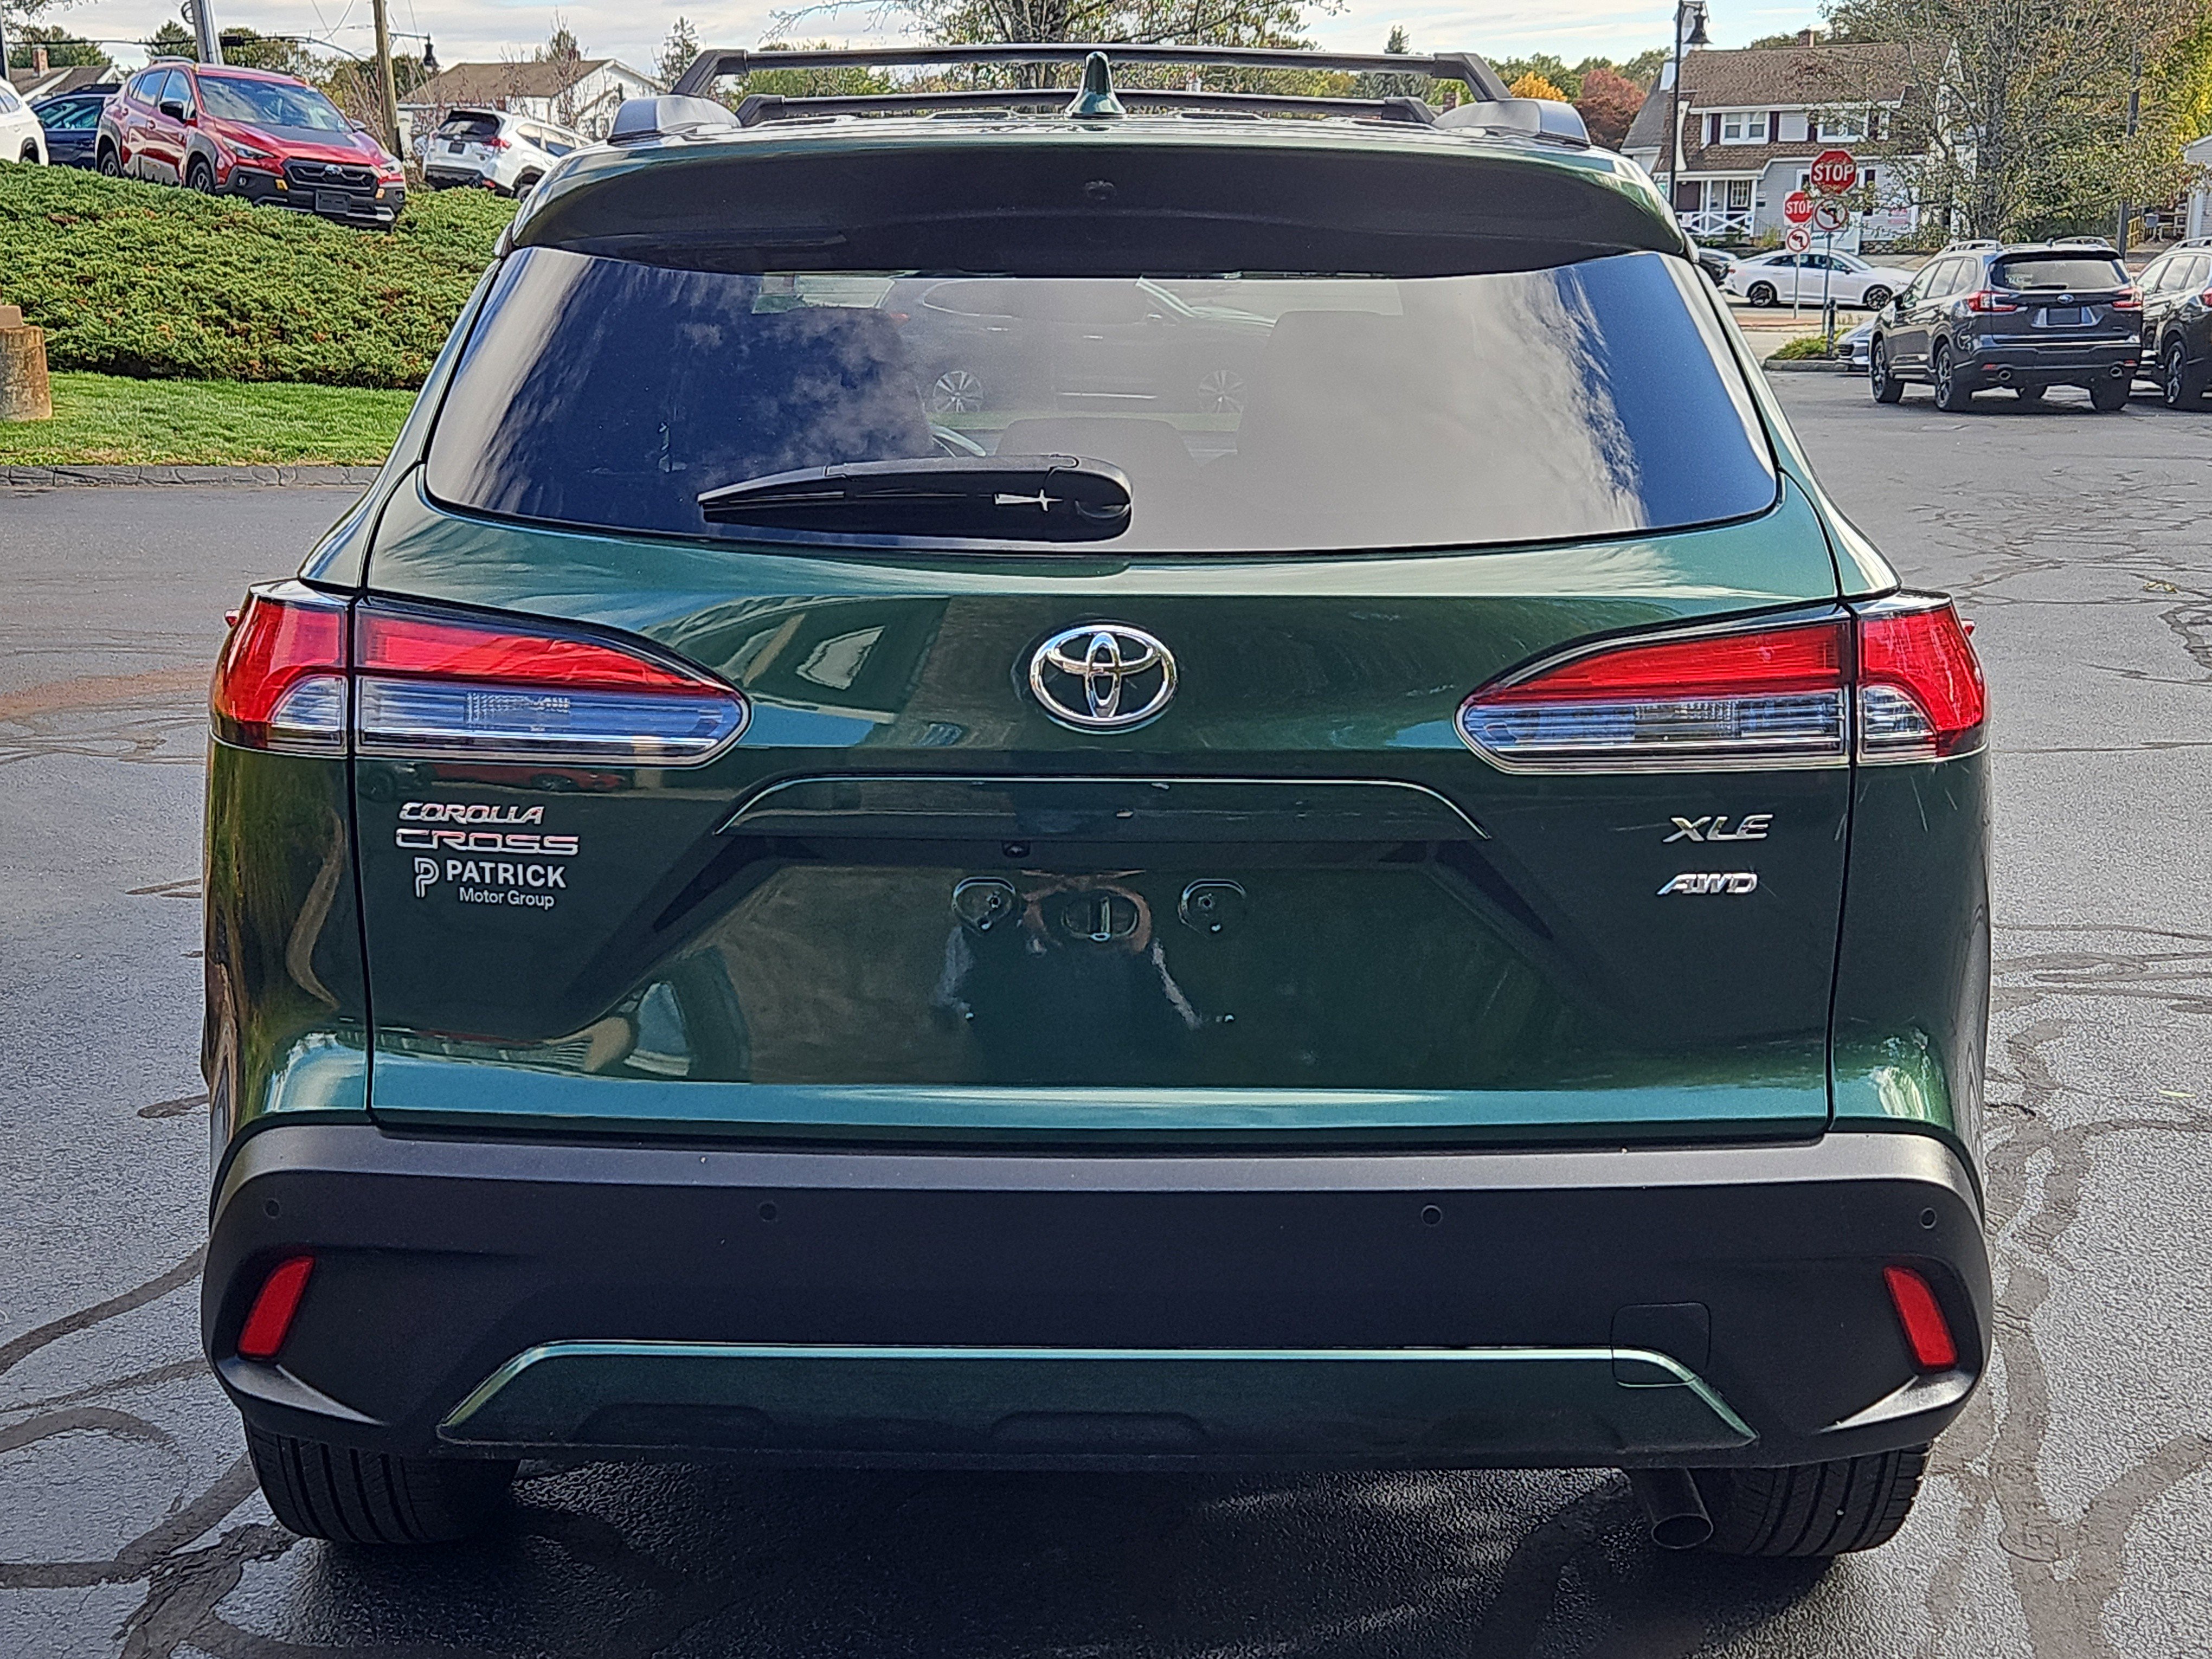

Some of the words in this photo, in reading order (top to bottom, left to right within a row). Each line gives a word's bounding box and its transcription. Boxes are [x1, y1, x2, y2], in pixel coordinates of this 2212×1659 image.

[1814, 164, 1854, 181] STOP
[1786, 201, 1814, 214] STOP
[398, 802, 544, 825] COROLLA
[1662, 814, 1773, 843] XLE
[396, 828, 580, 856] CROSS
[446, 859, 567, 888] PATRICK
[1656, 873, 1758, 895] AWD
[459, 887, 505, 905] Motor
[507, 890, 555, 910] Group
